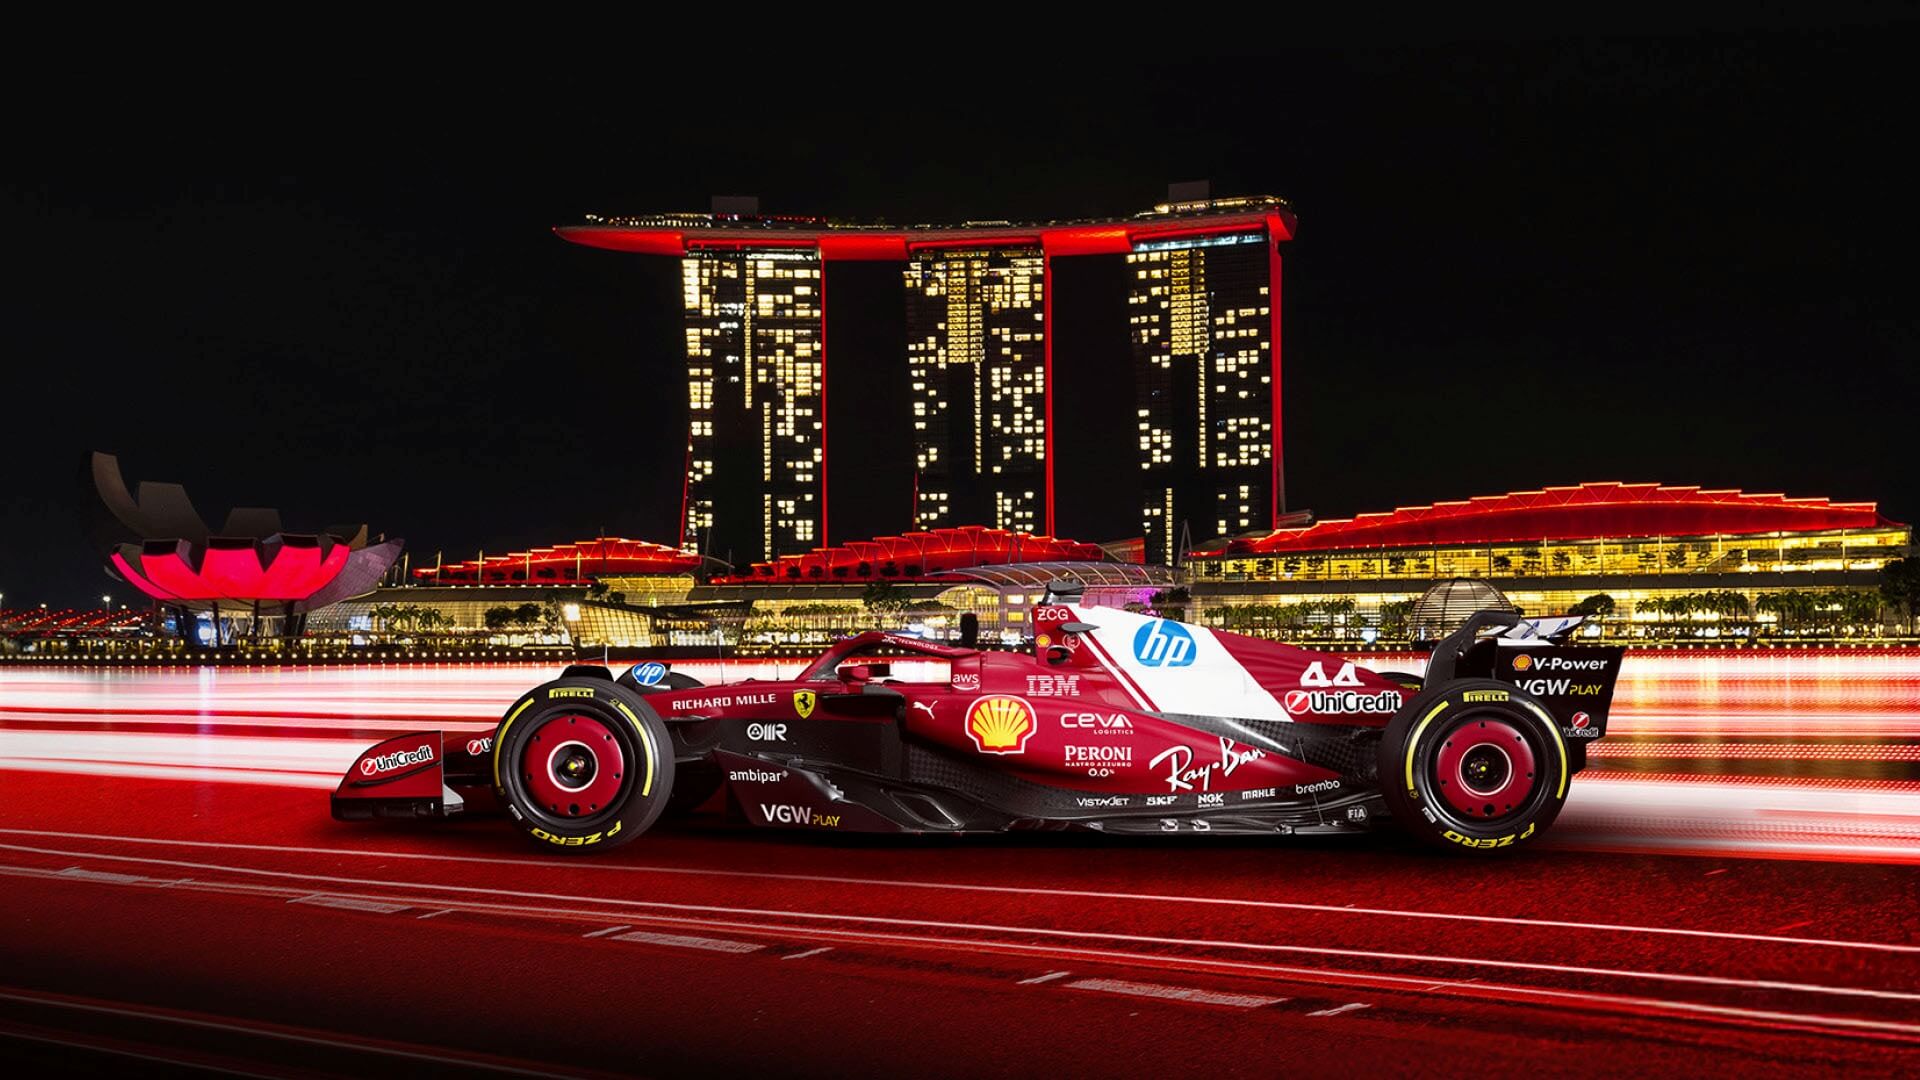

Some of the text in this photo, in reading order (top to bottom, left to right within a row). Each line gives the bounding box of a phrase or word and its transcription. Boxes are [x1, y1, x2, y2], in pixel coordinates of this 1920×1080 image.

[899, 638, 938, 650] TECHNOLOGY
[1138, 620, 1192, 668] hp
[1533, 657, 1608, 671] V-Power
[635, 662, 664, 686] hp
[952, 674, 979, 684] aws
[1300, 661, 1366, 688] 44
[549, 687, 595, 699] PIRELLI
[1026, 675, 1080, 696] IBM
[1569, 684, 1602, 695] PLAY
[672, 693, 776, 710] RICHARD MILLE
[1310, 691, 1401, 714] UniCredit
[1463, 690, 1510, 702] PIRELLI
[376, 745, 433, 771] UniCredit
[1064, 745, 1132, 761] PERONI
[729, 769, 782, 784] ambipar
[1242, 788, 1276, 800] MAHLE
[1295, 780, 1340, 795] brembo
[1145, 795, 1178, 805] SKF
[1198, 793, 1224, 804] NGK
[760, 804, 840, 827] VGW PLAY
[530, 820, 622, 846] P ZERO
[1443, 822, 1535, 849] P ZERO
